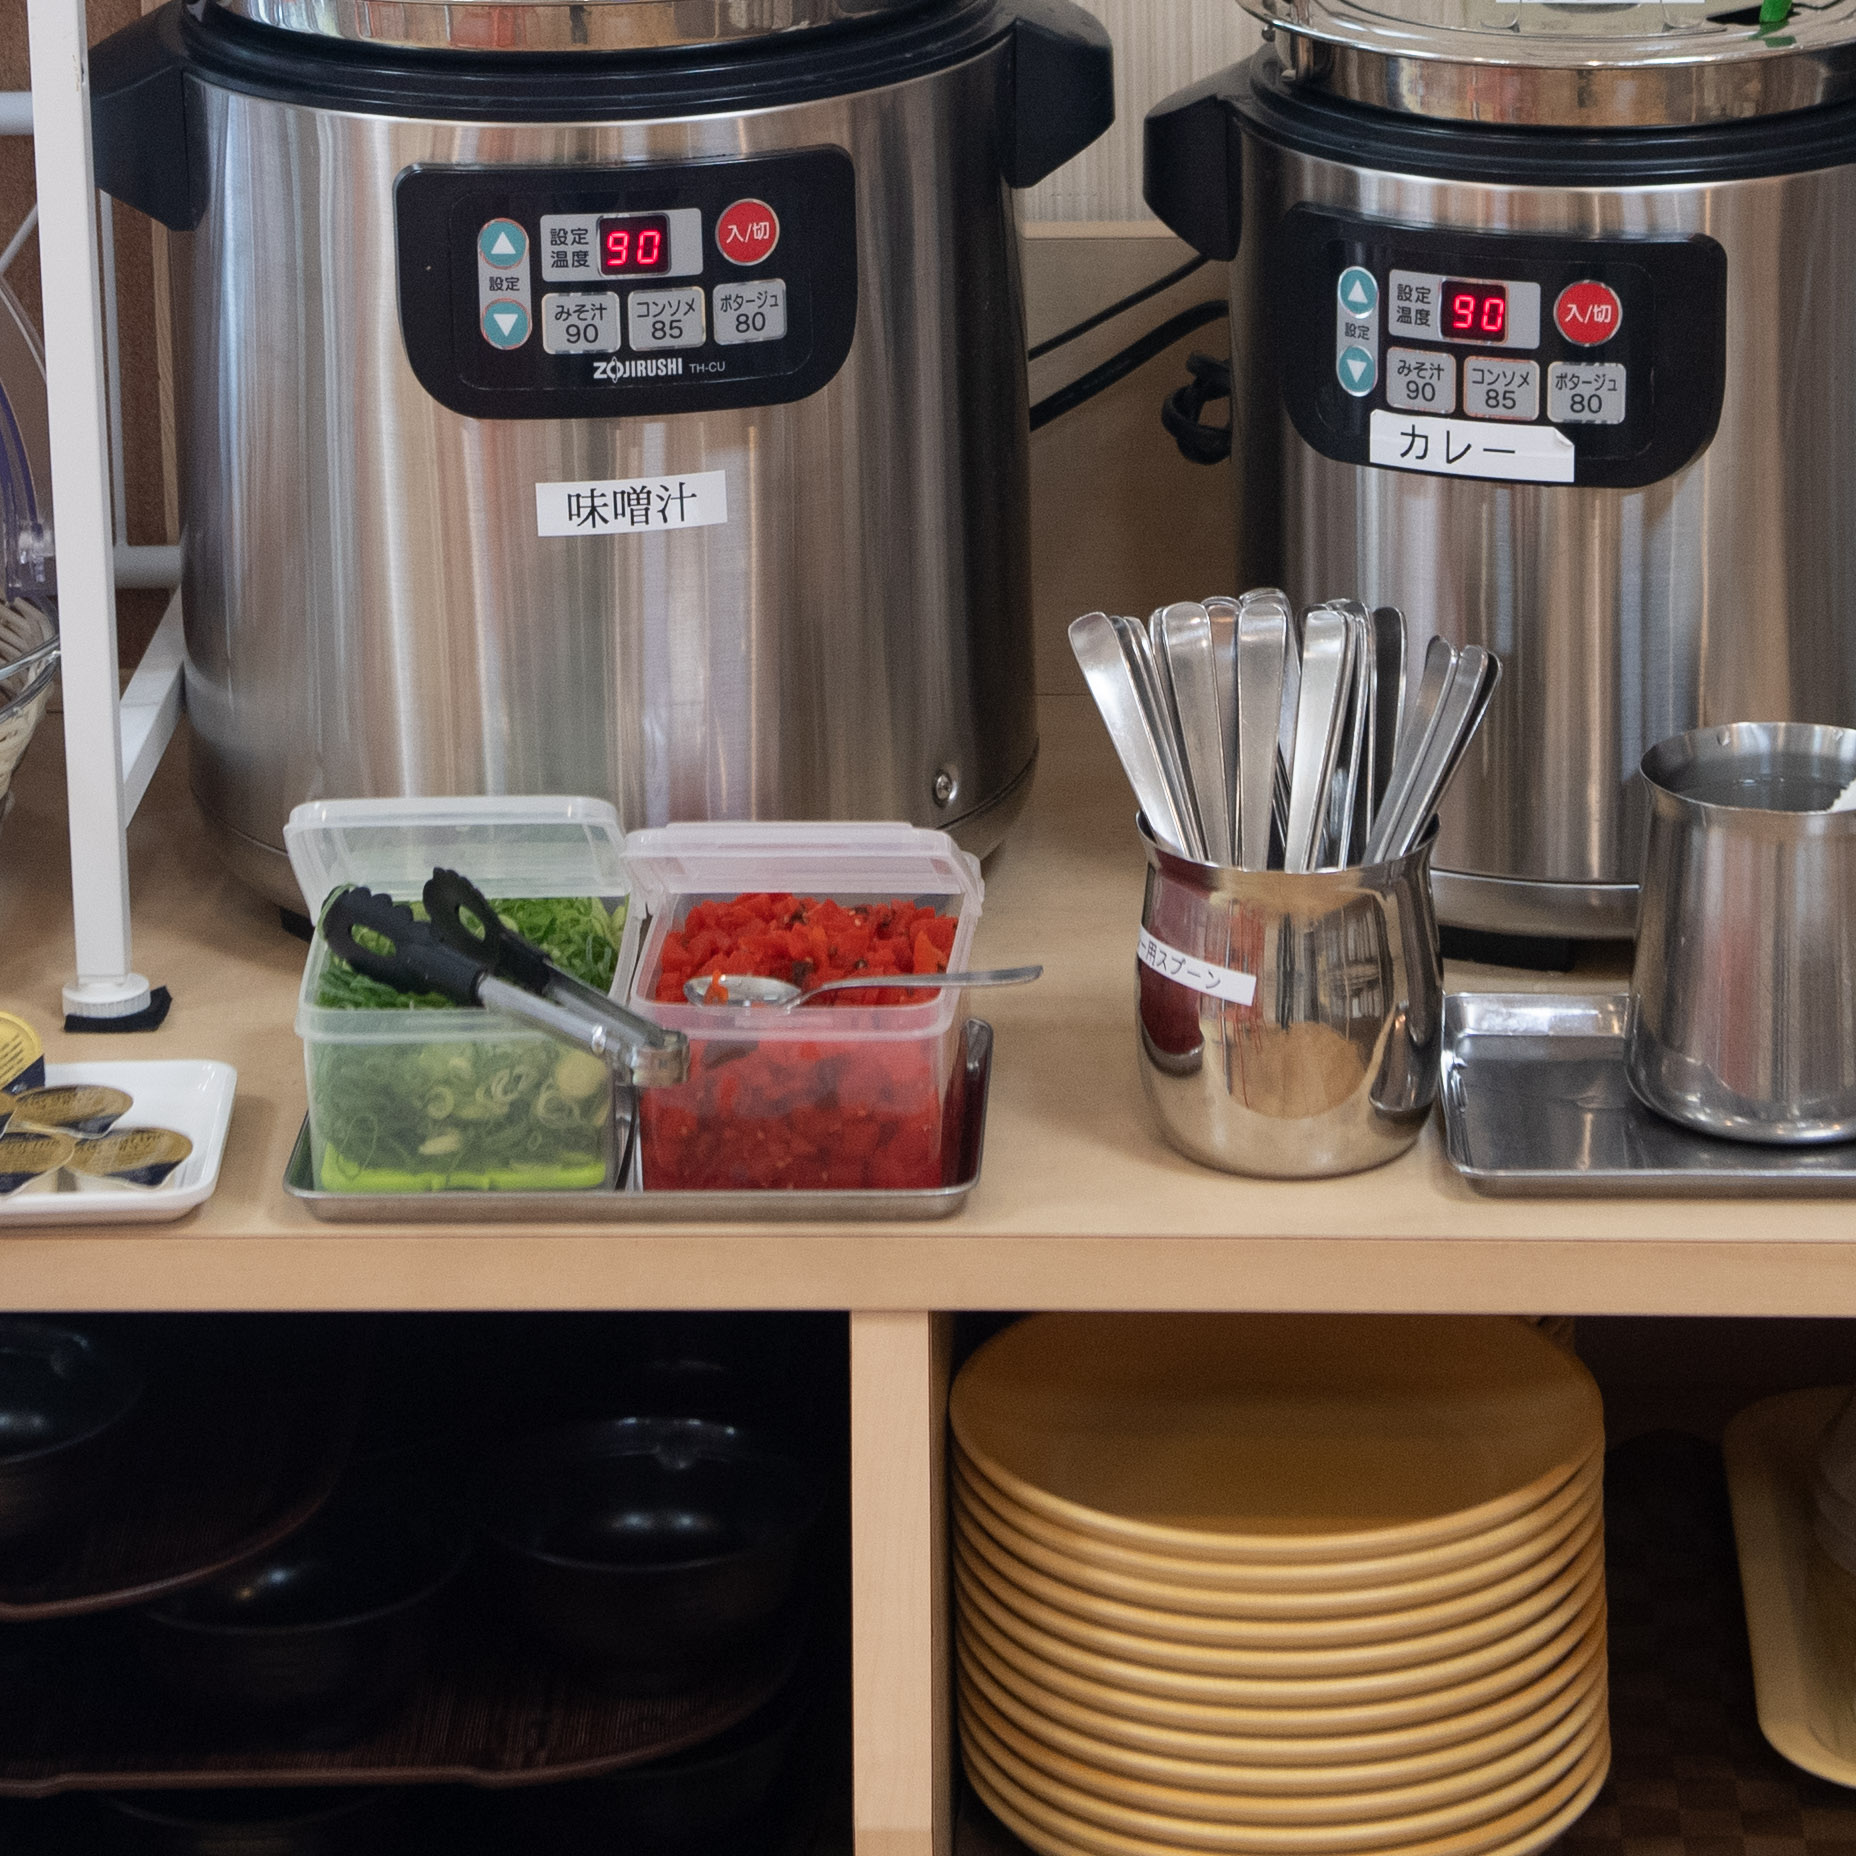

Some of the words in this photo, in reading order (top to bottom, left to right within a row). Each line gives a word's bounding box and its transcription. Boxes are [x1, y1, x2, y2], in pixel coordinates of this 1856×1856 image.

[550, 227, 590, 246] 設定
[726, 220, 771, 246] 入/切
[605, 228, 663, 267] 90
[550, 250, 590, 269] 温度
[488, 276, 521, 292] 設定
[1396, 283, 1432, 305] 設定
[554, 303, 607, 322] みそ汁
[636, 297, 696, 318] コンソメ
[719, 291, 780, 313] ポタージュ
[1452, 294, 1505, 332] 90
[735, 311, 766, 334] 80
[1396, 305, 1432, 327] 温度
[1564, 303, 1613, 324] 入/切
[565, 323, 600, 344] 90
[651, 319, 684, 341] 85
[1344, 321, 1371, 341] 設定
[593, 356, 683, 384] ZOJIRUSHI
[689, 361, 726, 374] TH-CU
[1396, 359, 1445, 382] みそ汁
[1471, 367, 1531, 389] コンソメ
[1405, 380, 1436, 402] 90
[1554, 372, 1619, 393] ポタージュ
[1485, 388, 1517, 411] 85
[1569, 393, 1604, 414] 80
[1399, 424, 1517, 466] カレー
[566, 482, 697, 530] 味噌汁
